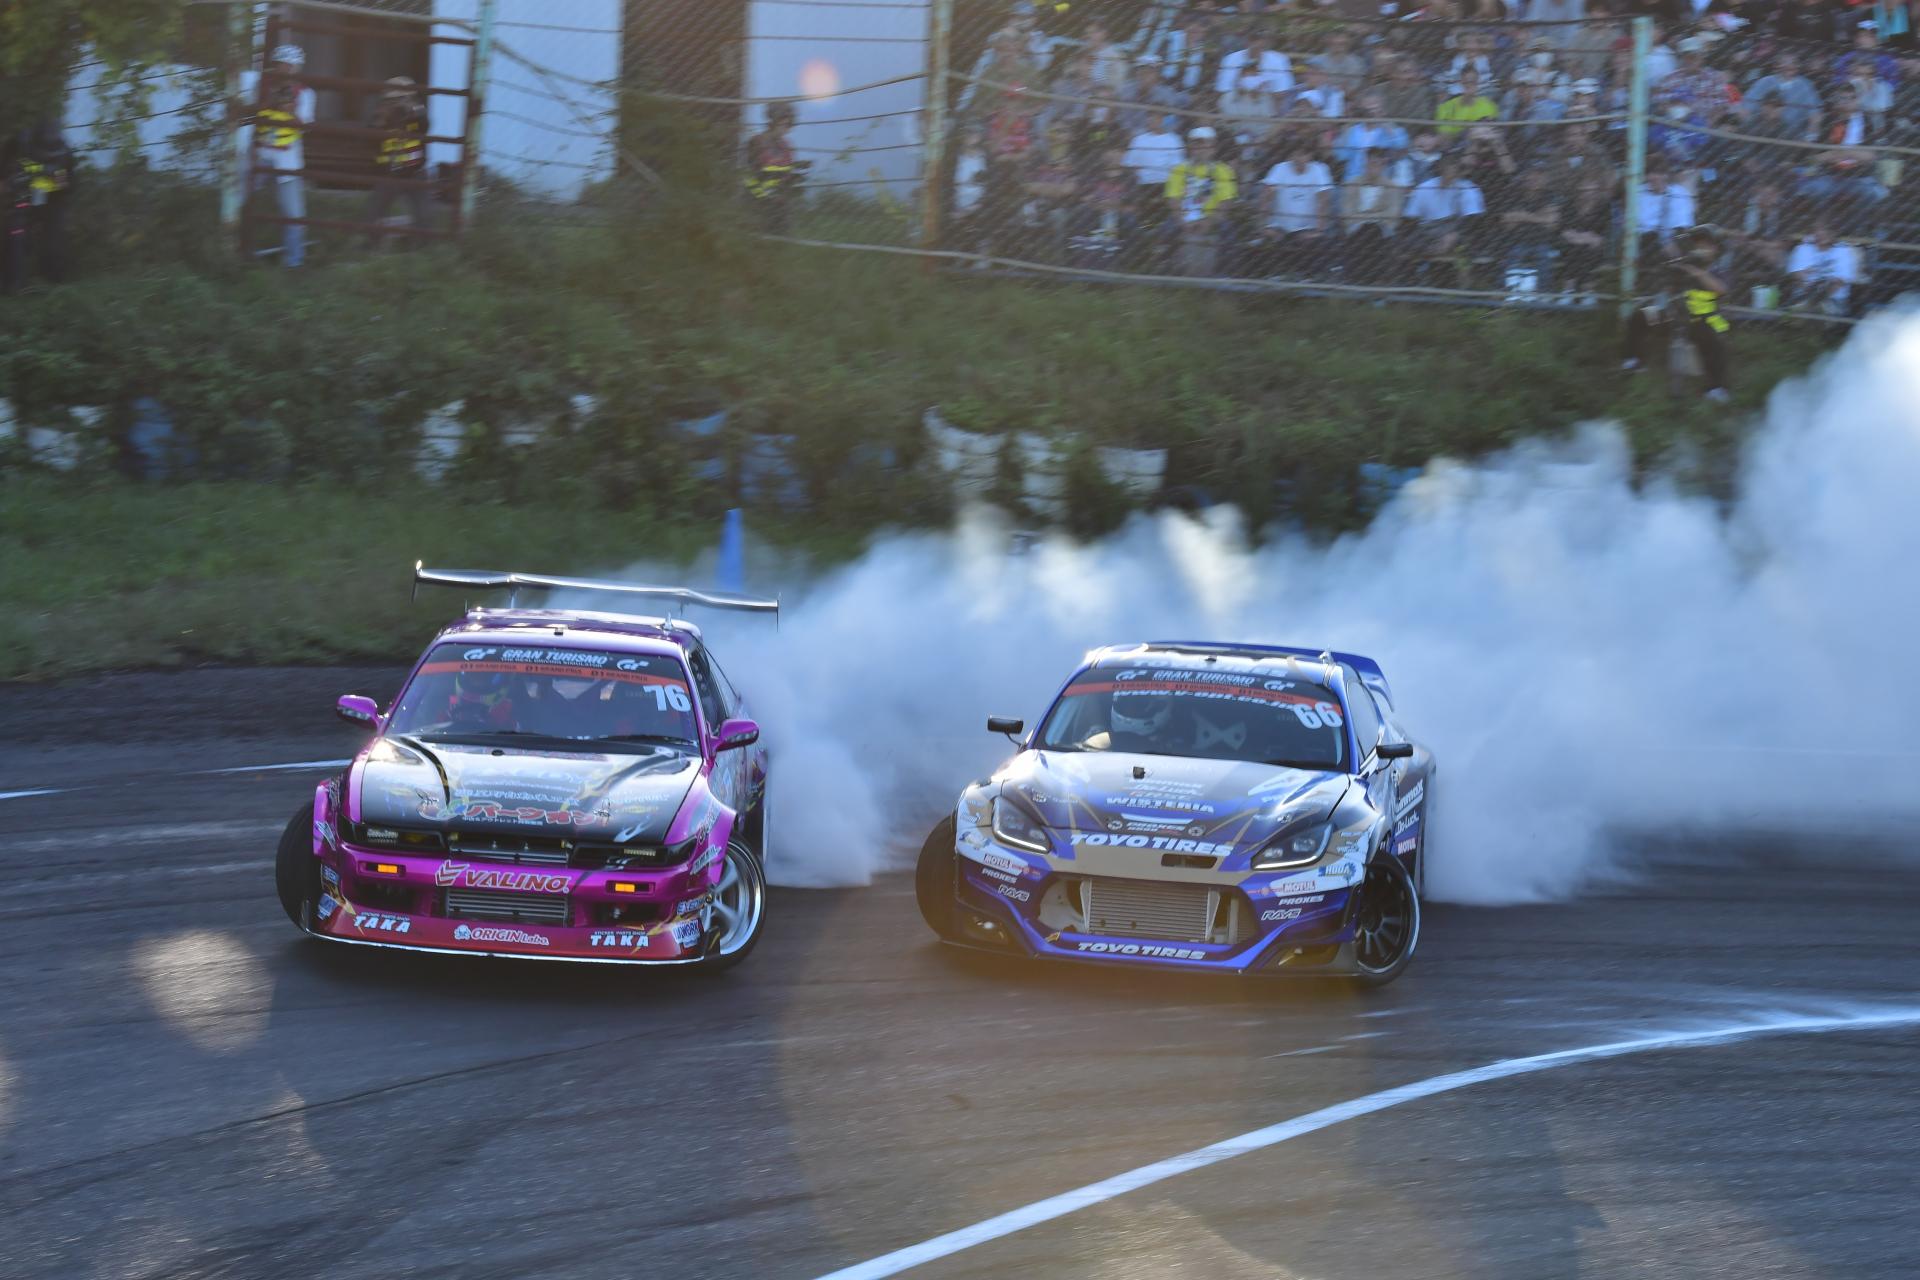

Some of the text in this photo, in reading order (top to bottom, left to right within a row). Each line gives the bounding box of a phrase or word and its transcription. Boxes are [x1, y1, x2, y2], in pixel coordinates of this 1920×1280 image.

[502, 649, 608, 665] GRAN TURISMO
[1152, 671, 1191, 680] GRAN
[1194, 672, 1256, 685] TURISMO
[643, 684, 691, 712] 76
[1293, 702, 1342, 729] 66
[1070, 833, 1234, 856] TOYO TIRES
[465, 869, 571, 893] VALINO
[1279, 895, 1325, 906] PROXES
[353, 914, 411, 933] TAKA
[471, 927, 522, 944] ORIGIN
[590, 935, 649, 947] TAKA
[1078, 942, 1206, 960] TOYO TIRES
